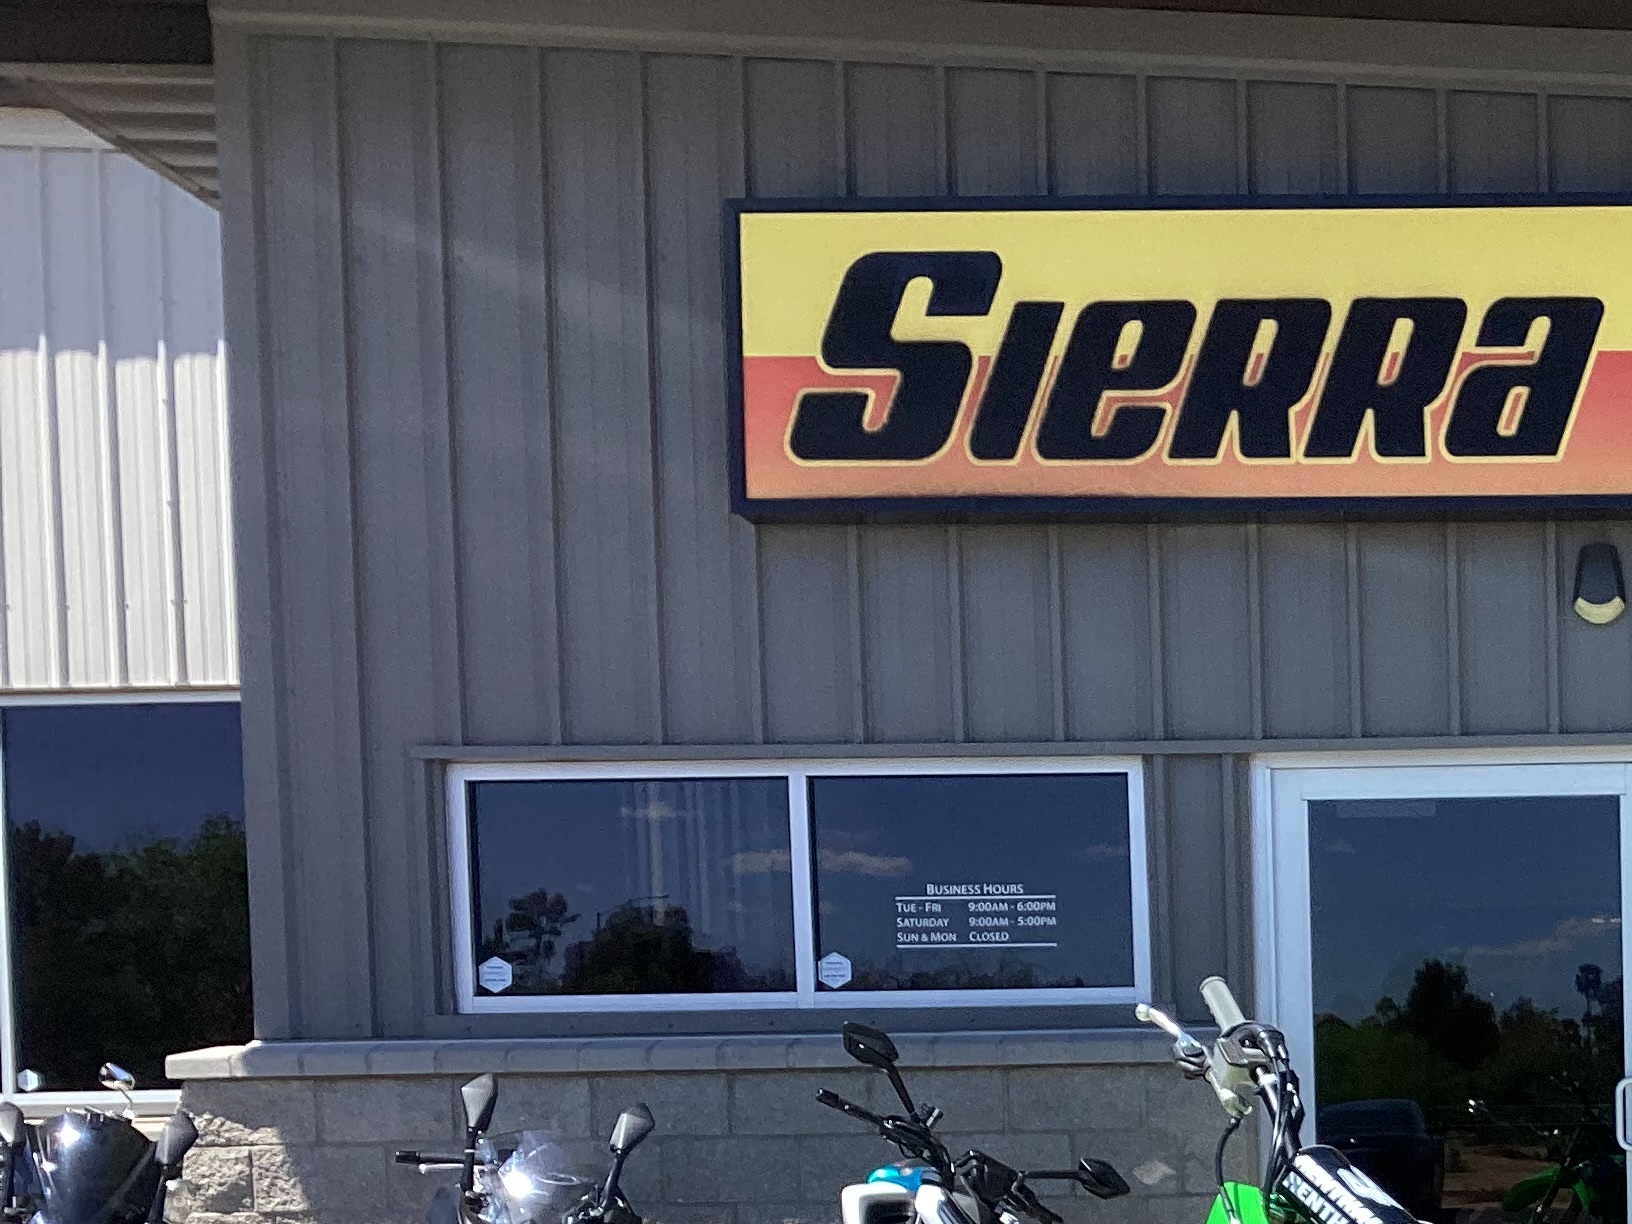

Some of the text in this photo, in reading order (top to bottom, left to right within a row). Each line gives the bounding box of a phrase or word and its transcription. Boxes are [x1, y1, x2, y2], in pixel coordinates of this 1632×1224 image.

[968, 901, 1009, 912] 9:00AM
[1017, 901, 1056, 911] 6:00PM
[968, 916, 1009, 927] 9:00AM
[1017, 916, 1057, 926] 5:00PM
